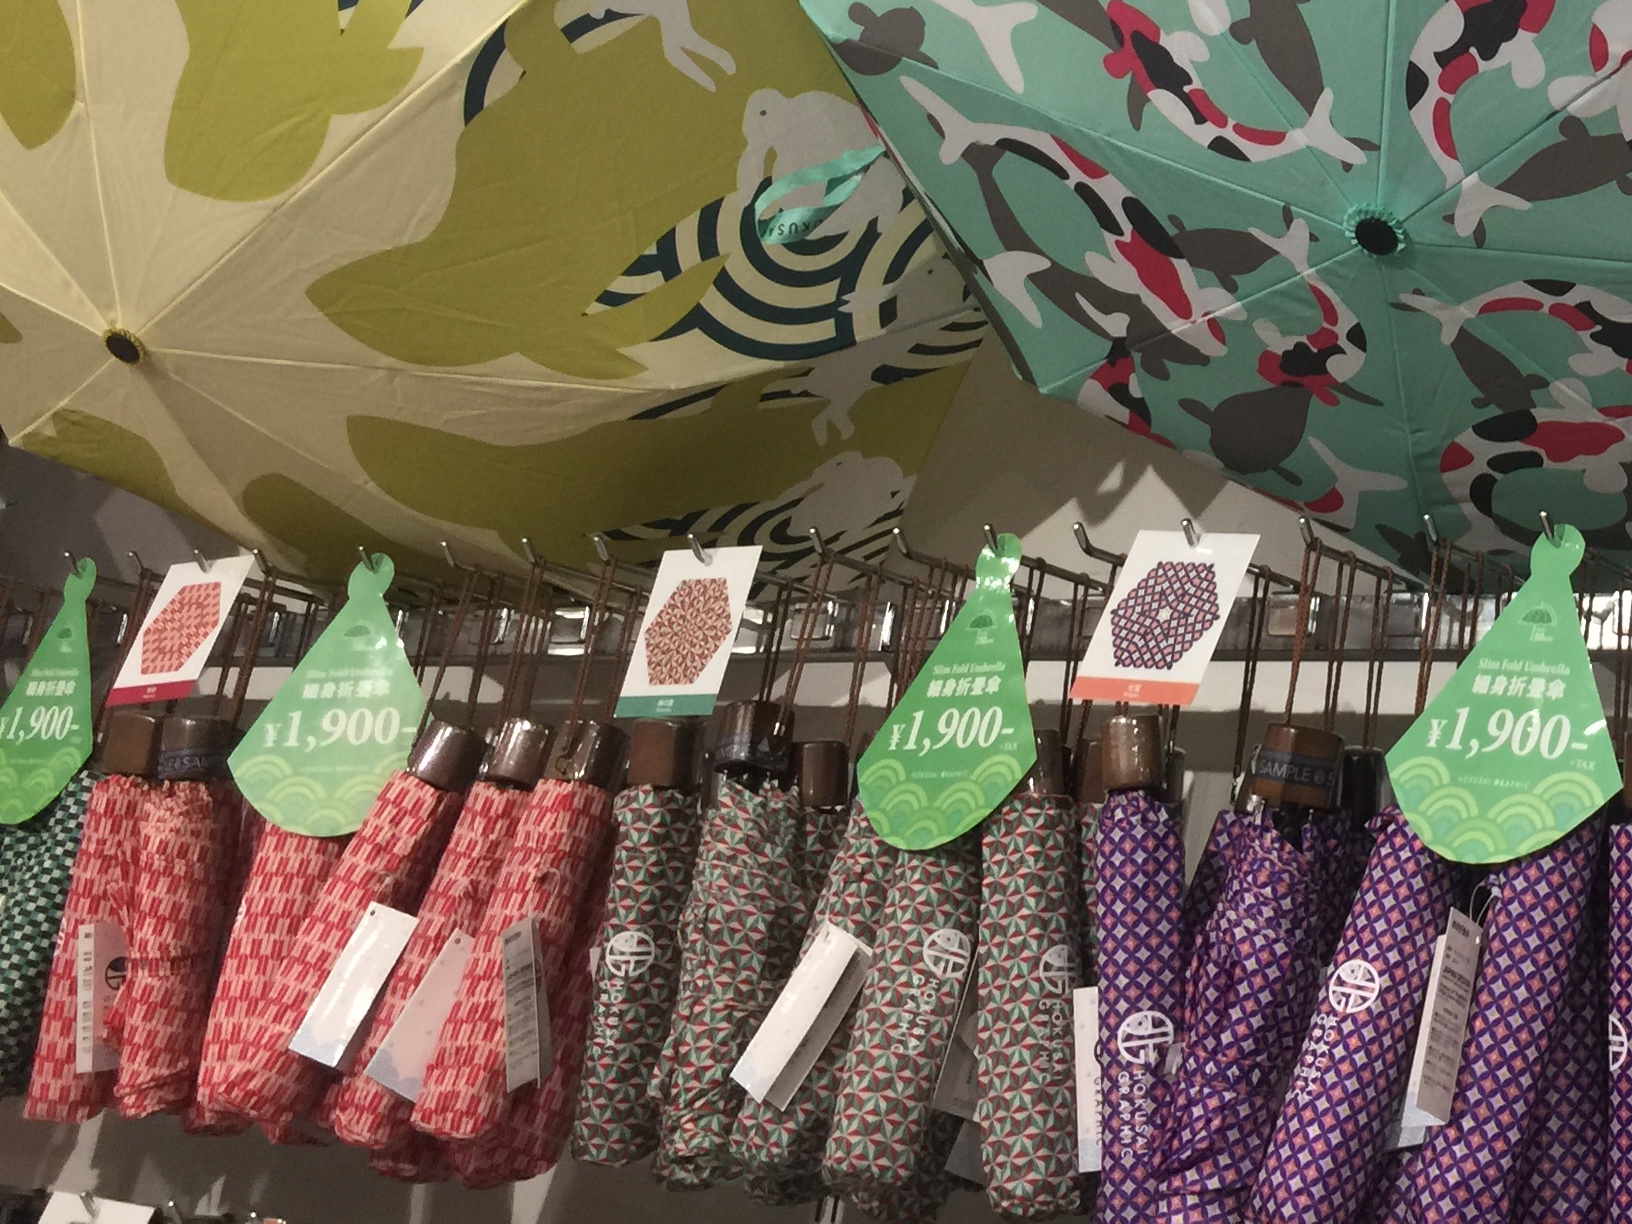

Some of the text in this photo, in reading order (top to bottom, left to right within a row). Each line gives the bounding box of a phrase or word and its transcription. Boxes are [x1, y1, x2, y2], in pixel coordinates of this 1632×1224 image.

[1478, 658, 1571, 675] Slim Fold Umbrella
[262, 706, 417, 753] ¥1,900-
[888, 705, 1014, 757] ¥1,900-
[1425, 706, 1589, 759] ¥1,900-
[1259, 759, 1312, 783] SAMPLE
[1117, 1071, 1134, 1158] GRAPHIC
[1132, 1069, 1149, 1154] HOKUSAI
